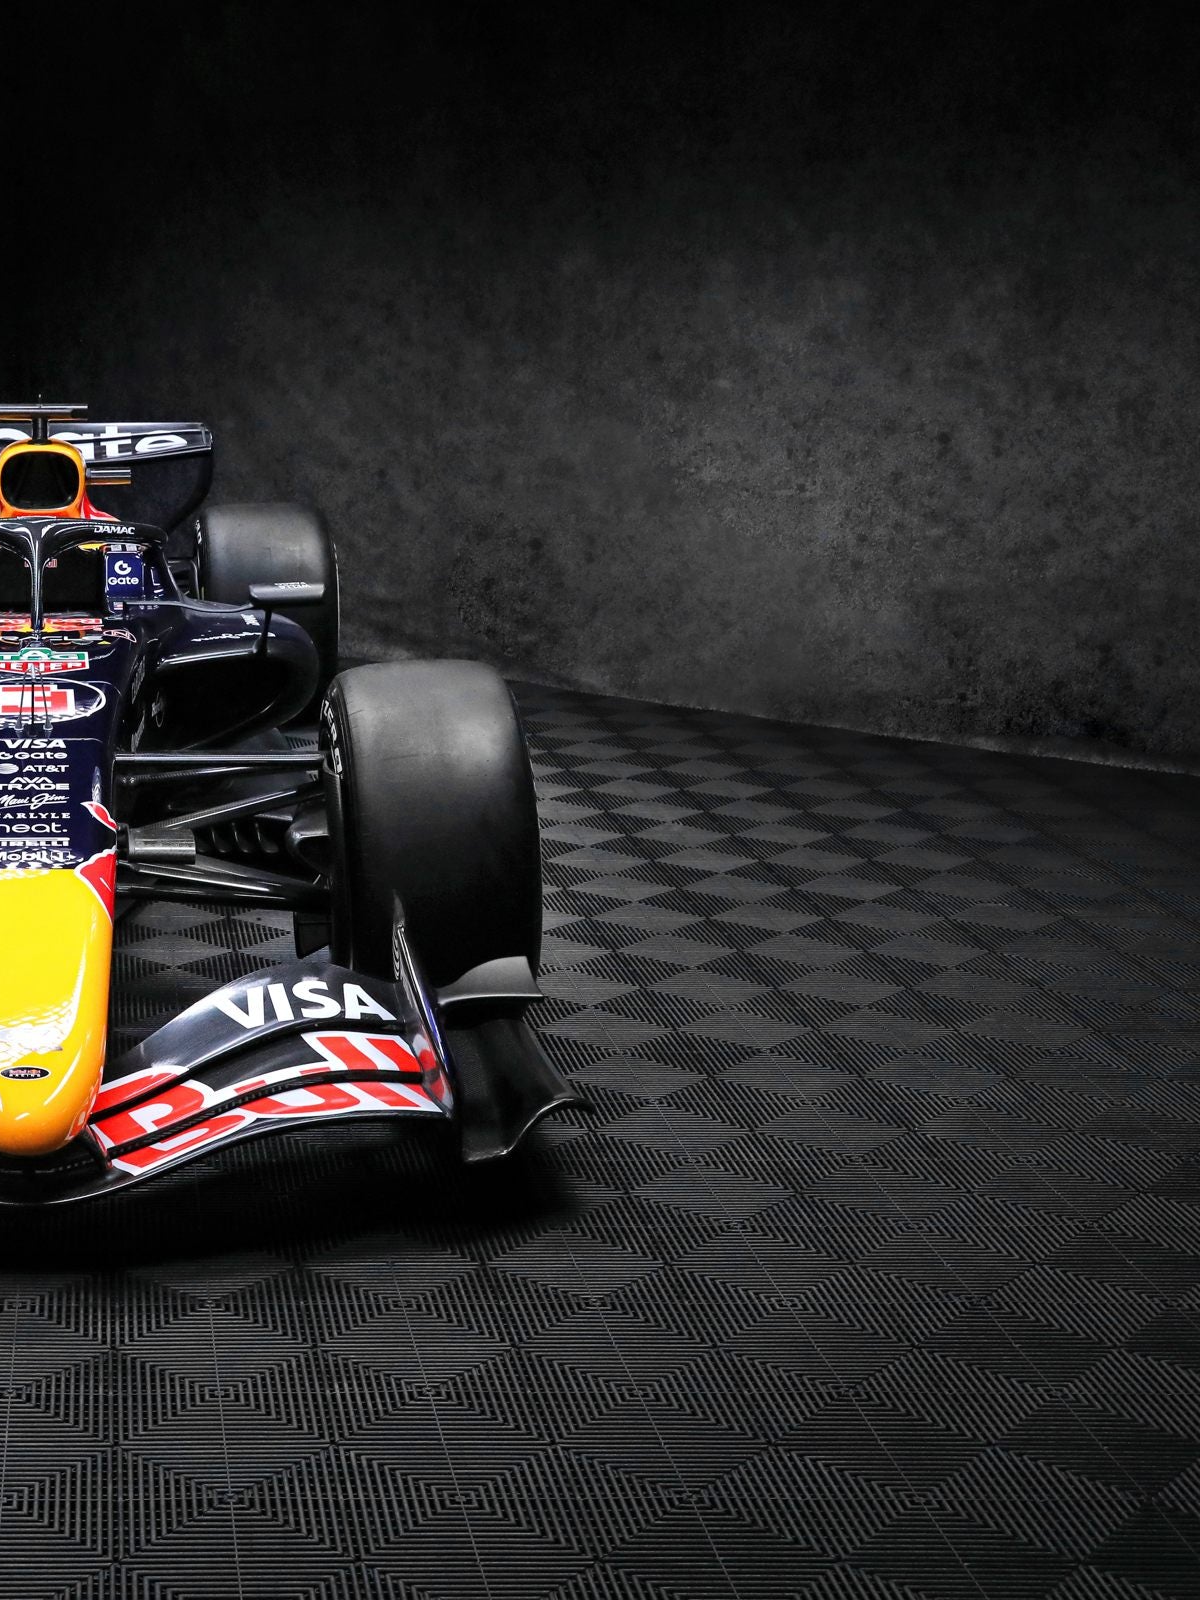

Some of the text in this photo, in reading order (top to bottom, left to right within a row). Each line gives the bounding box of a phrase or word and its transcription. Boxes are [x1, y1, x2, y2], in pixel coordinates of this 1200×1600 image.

[94, 525, 136, 535] DAMAC
[108, 575, 139, 586] Gate
[2, 738, 67, 749] VISA
[14, 751, 68, 760] Gate
[22, 764, 70, 773] AT&T
[10, 776, 53, 784] AVA
[30, 793, 70, 810] Jim
[211, 980, 397, 1030] VISA
[88, 1030, 444, 1176] Bull
